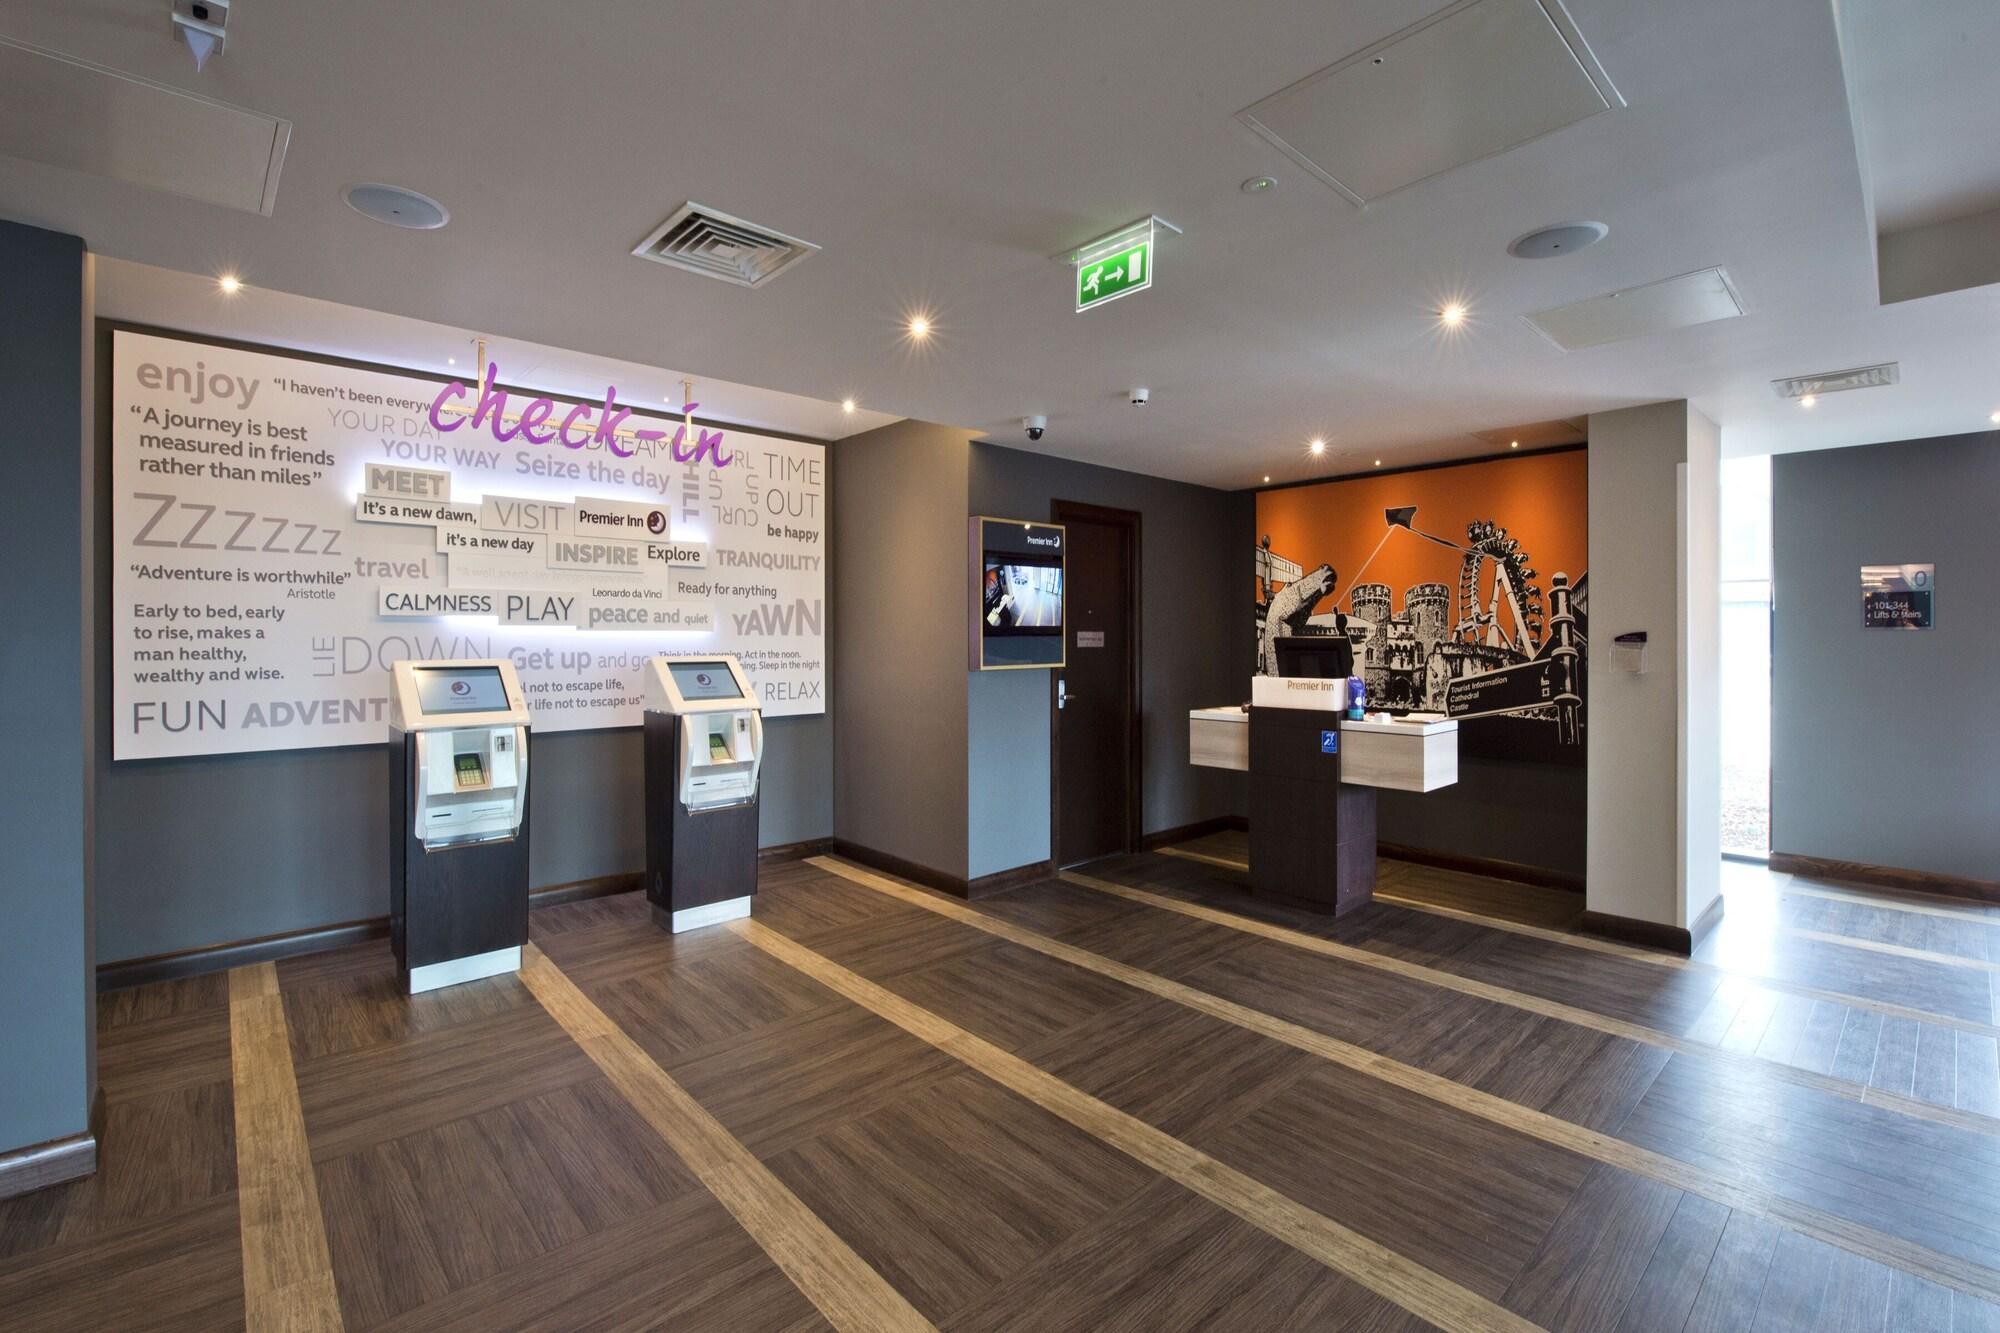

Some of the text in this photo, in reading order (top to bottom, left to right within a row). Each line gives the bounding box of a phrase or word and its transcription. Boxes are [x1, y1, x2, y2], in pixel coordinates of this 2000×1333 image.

[137, 361, 260, 410] enjoy
[290, 379, 345, 400] haven’t
[348, 389, 383, 405] been
[130, 405, 308, 442] “A journey is best
[328, 407, 395, 435] YOUR
[429, 362, 733, 468] check-in
[140, 433, 335, 467] measured in friends
[381, 439, 501, 468] YOUR WAY
[139, 456, 322, 487] rather than miles”
[516, 451, 670, 494] Seize the day
[763, 452, 821, 486] TIME
[371, 467, 445, 496] MEET
[363, 501, 478, 524] It’s a new dawn,
[767, 488, 819, 518] OUT
[495, 501, 566, 531] VISIT
[580, 510, 645, 529] Premier Inn
[446, 532, 534, 554] it’s a new day
[768, 524, 819, 543] be happy
[1027, 536, 1045, 546] Premier
[555, 543, 639, 566] INSPIRE
[648, 545, 700, 562] Explore
[717, 549, 821, 571] TRANQUILITY
[130, 565, 351, 586] “Adventure is worthwhile”
[354, 556, 429, 580] travel
[287, 588, 335, 600] Aristotle
[592, 587, 663, 599] Leonardo da Vinci
[678, 581, 777, 600] Ready for anything
[133, 604, 285, 622] Early to bed, early
[385, 593, 492, 612] CALMNESS
[507, 596, 575, 621] PLAY
[589, 605, 708, 628] peace and quiet
[731, 598, 821, 636] YAWN
[1874, 610, 1922, 619] Lifts & Stairs
[133, 625, 265, 641] to rise, makes a
[133, 646, 247, 664] man healthy,
[312, 636, 335, 677] LIE
[342, 635, 491, 675] DOWN
[508, 647, 554, 670] Get
[561, 650, 591, 675] up
[598, 652, 626, 668] and
[759, 651, 766, 659] in
[768, 651, 780, 659] the
[759, 661, 779, 671] Sleep
[780, 661, 787, 669] in
[789, 661, 801, 669] the
[802, 661, 820, 671] night
[134, 667, 284, 685] wealthy and wise.
[530, 682, 549, 693] not
[552, 681, 563, 692] to
[566, 681, 603, 693] escape
[606, 679, 625, 691] life,
[1287, 680, 1334, 691] Premier Inn
[1451, 676, 1508, 693] Tourist Information
[765, 681, 821, 701] RELAX
[1450, 691, 1480, 703] Cathedral
[534, 699, 552, 711] life
[555, 698, 574, 709] not
[576, 698, 588, 708] to
[590, 696, 626, 709] escape
[1450, 703, 1469, 712] Castle
[133, 700, 226, 734] FUN
